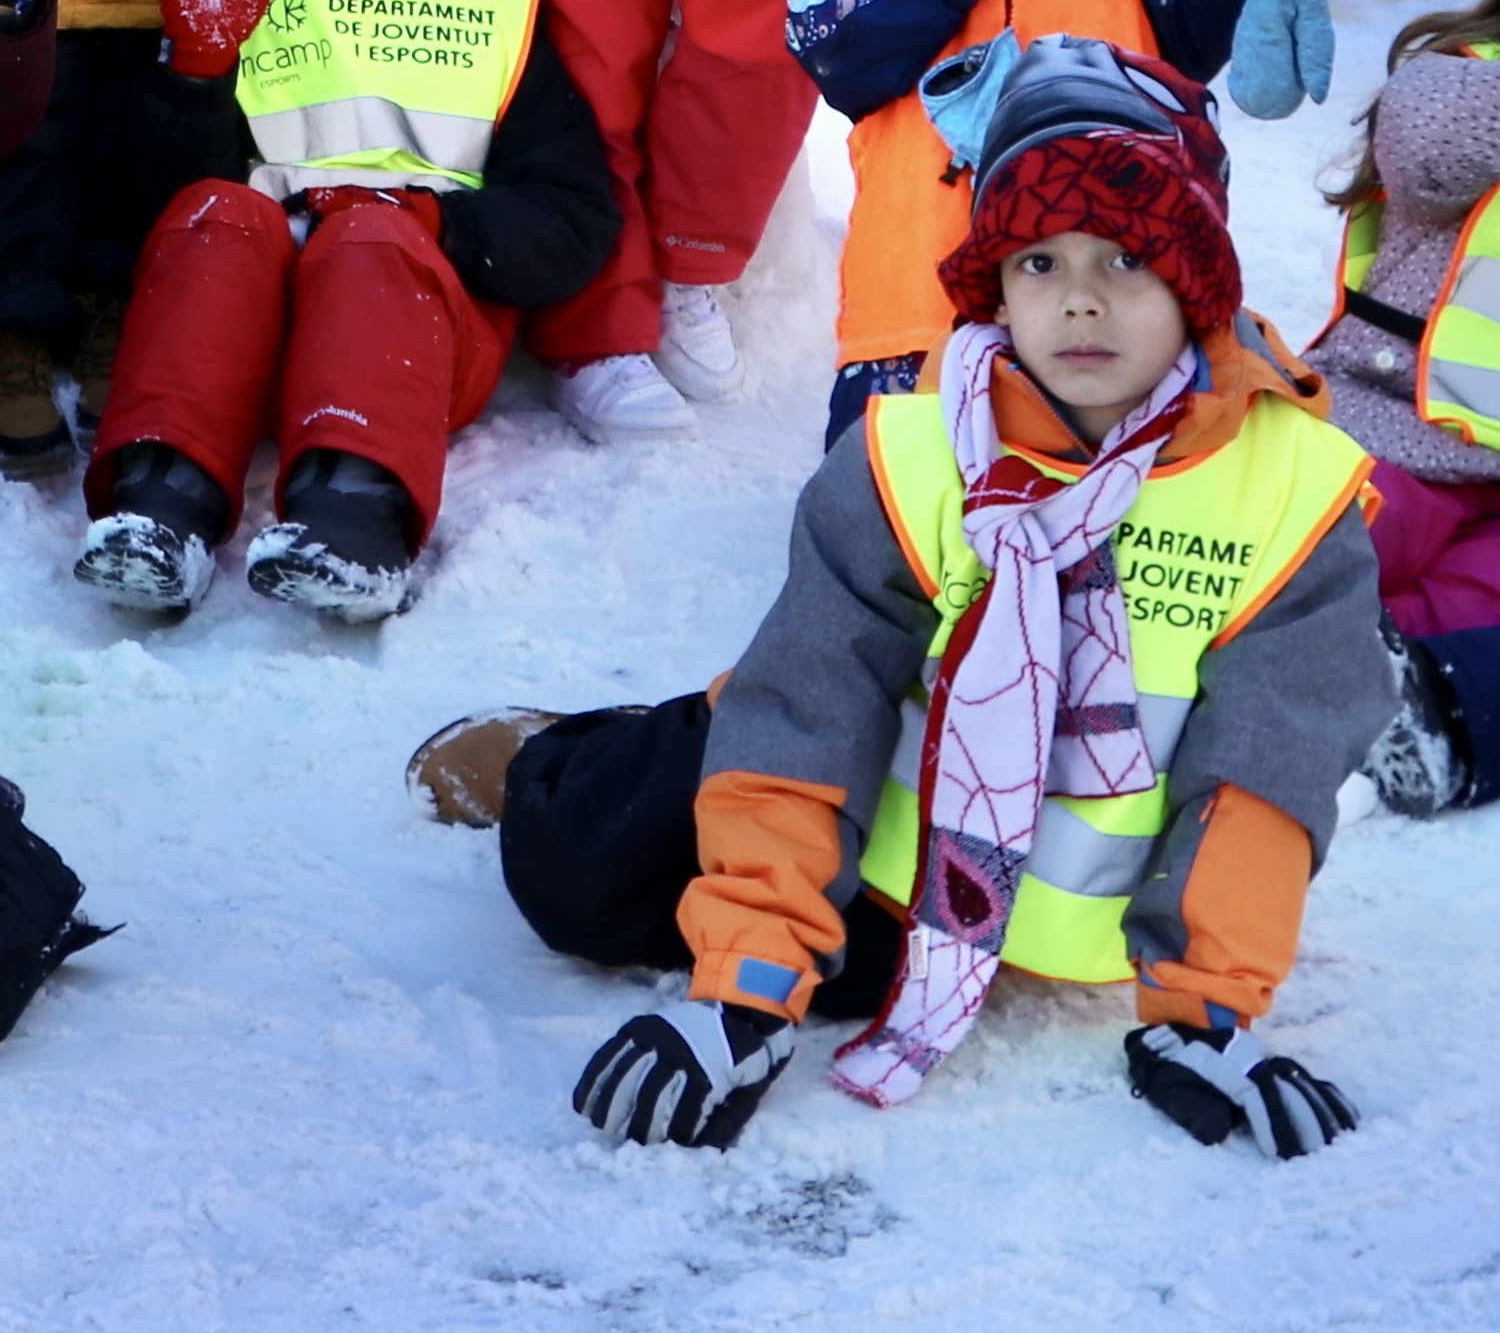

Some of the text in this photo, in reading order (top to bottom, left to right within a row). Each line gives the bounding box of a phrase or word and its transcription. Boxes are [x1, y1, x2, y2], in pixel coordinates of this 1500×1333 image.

[334, 19, 493, 48] DE JOVENTUT
[240, 37, 333, 80] ncamp
[368, 45, 475, 70] ESPORTS
